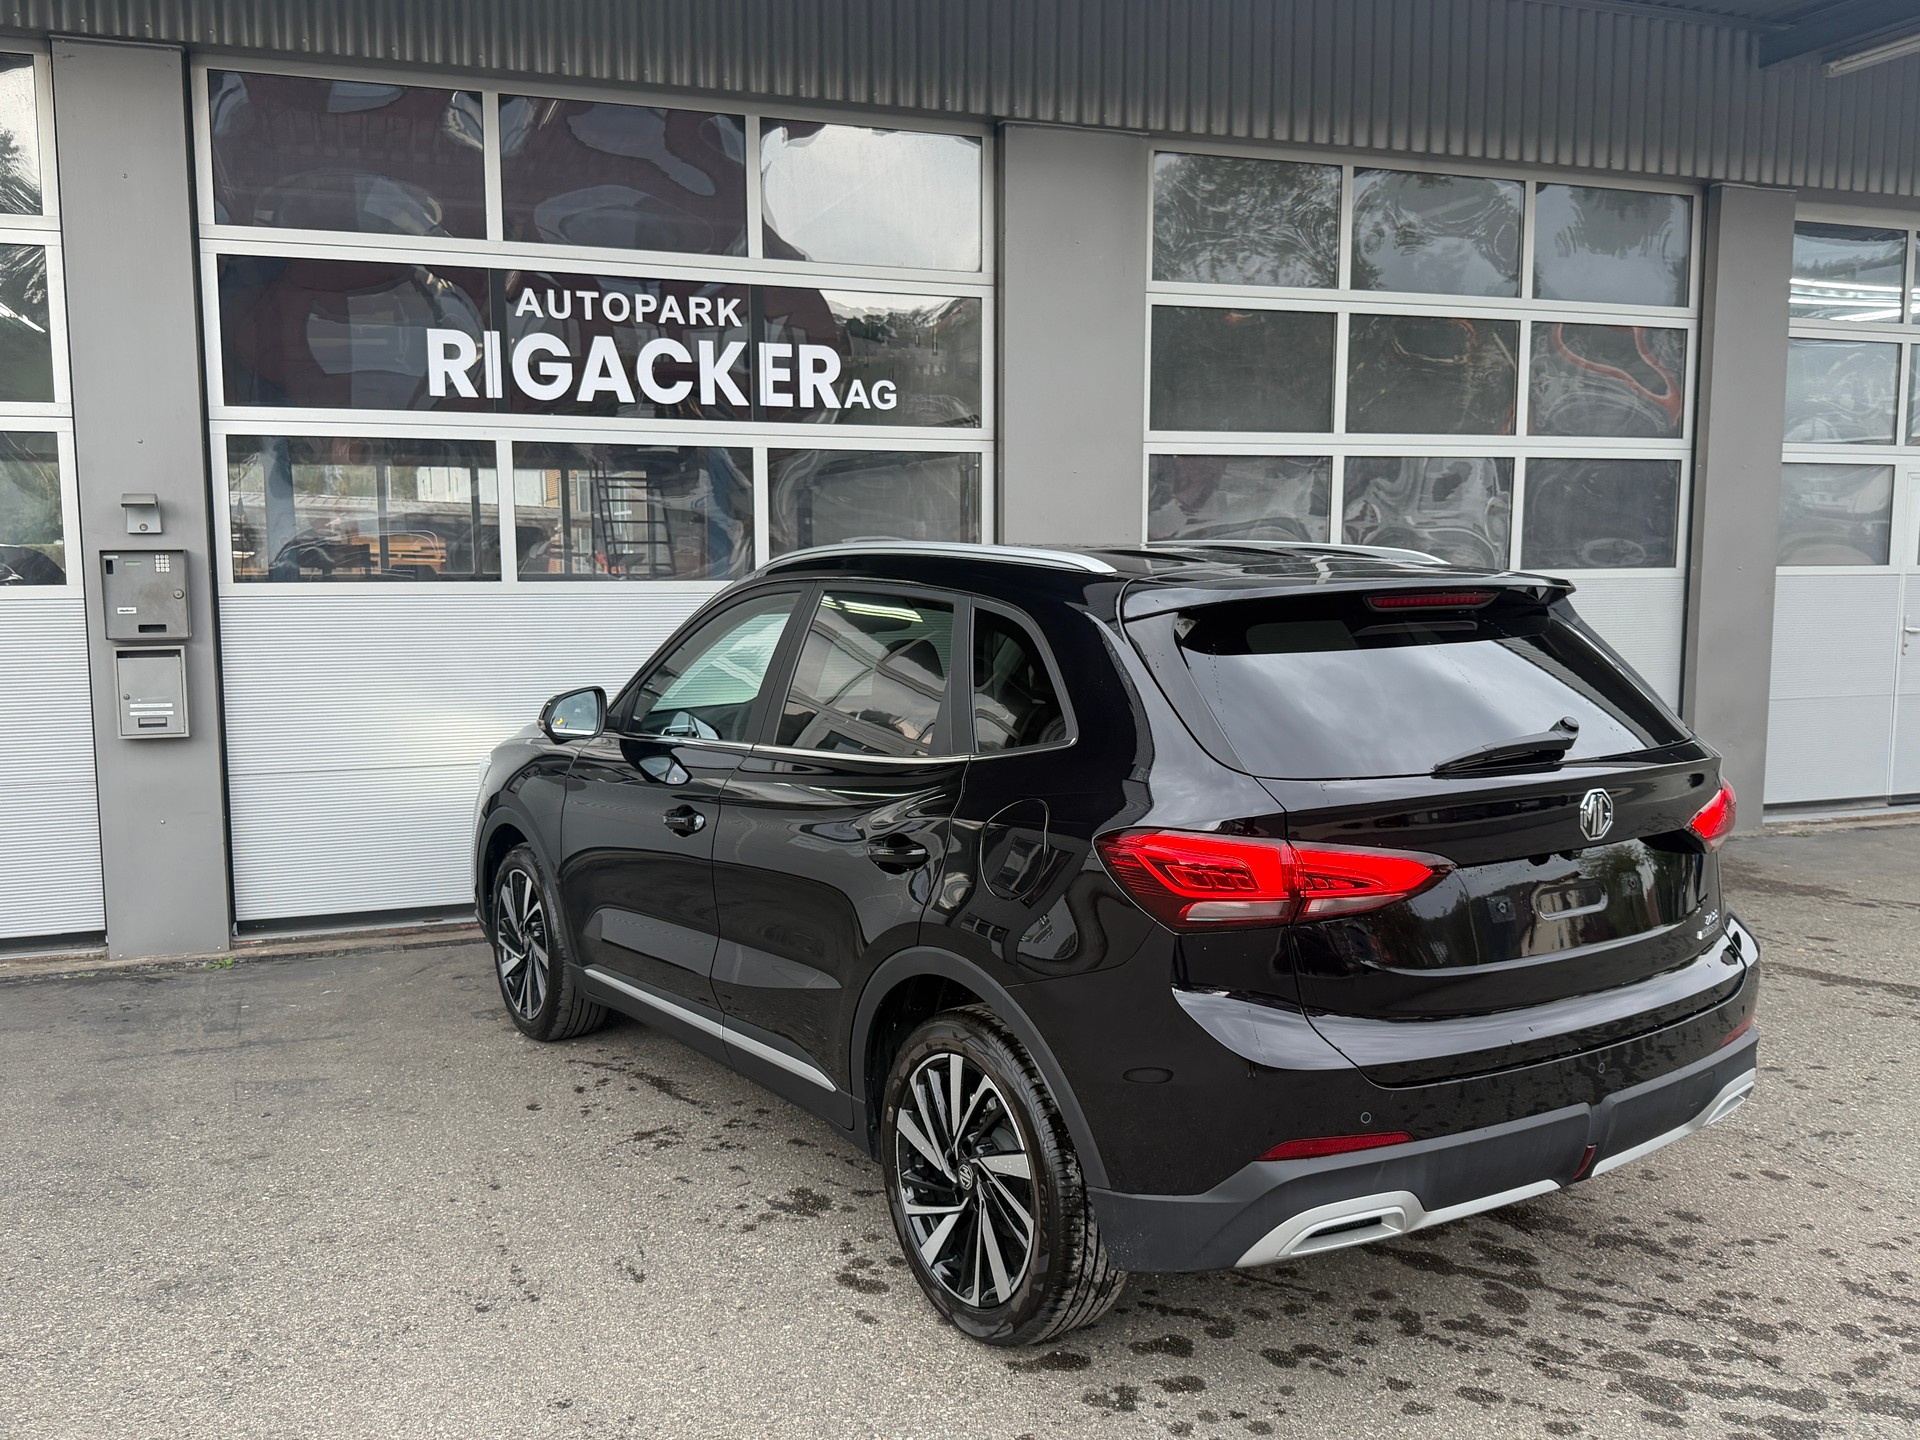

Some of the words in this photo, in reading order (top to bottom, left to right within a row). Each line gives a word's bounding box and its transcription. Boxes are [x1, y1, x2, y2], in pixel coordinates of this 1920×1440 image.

[514, 287, 743, 327] AUTOPARK
[426, 328, 842, 409] RIGACKER
[844, 378, 898, 410] AG
[1581, 790, 1612, 839] MG
